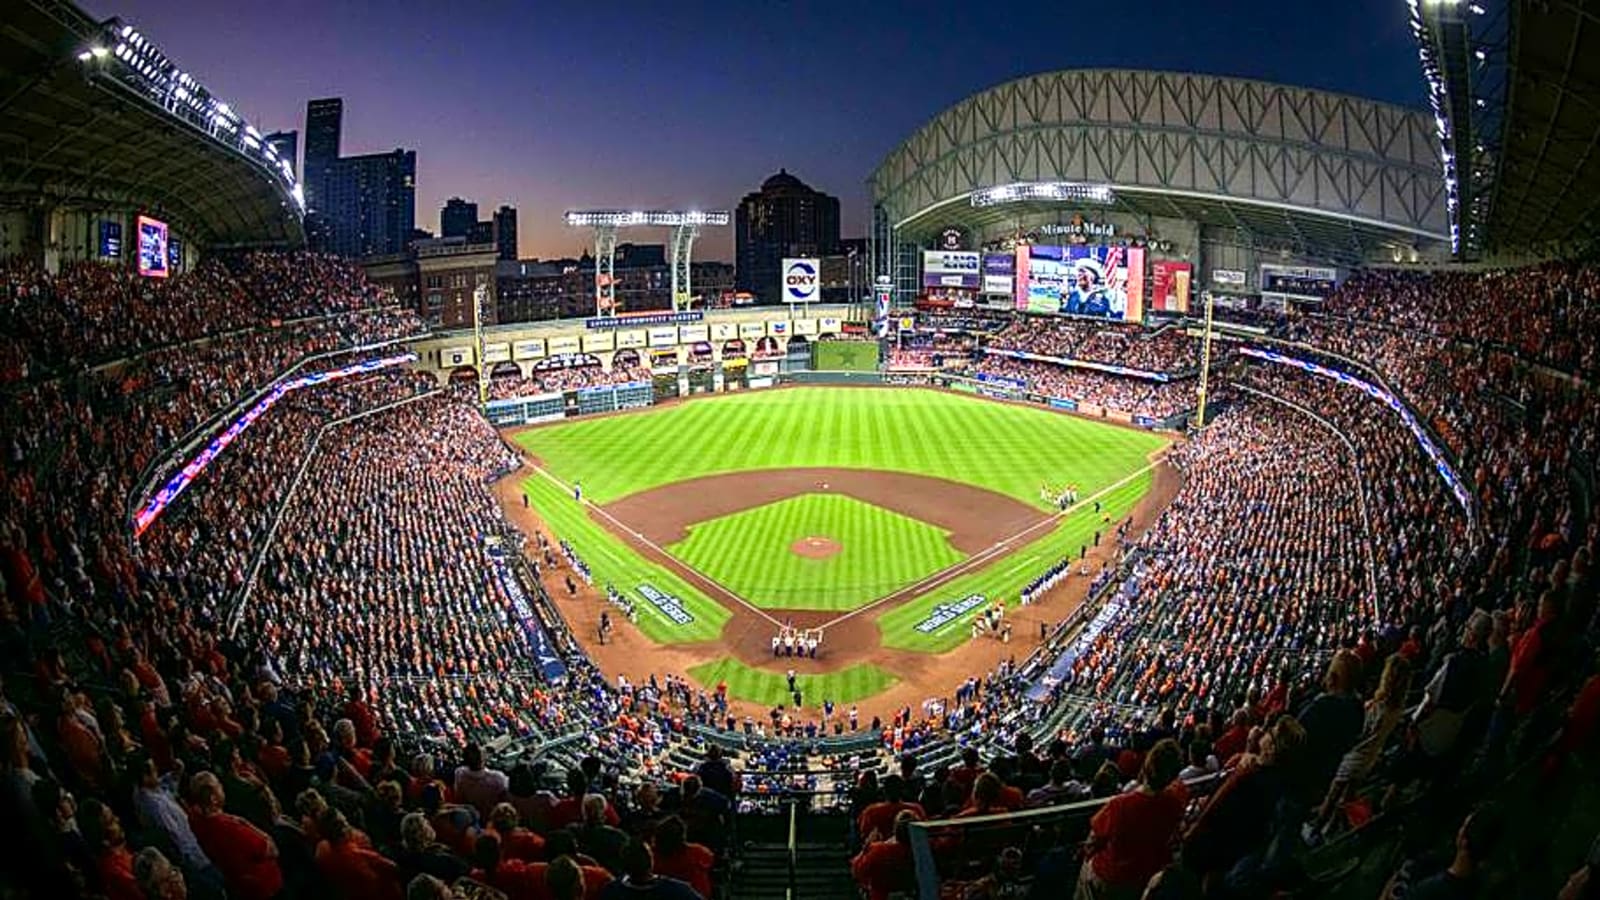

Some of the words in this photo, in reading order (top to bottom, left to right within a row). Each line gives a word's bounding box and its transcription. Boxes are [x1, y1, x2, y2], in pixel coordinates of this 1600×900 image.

[1040, 223, 1081, 236] Minute
[1083, 221, 1114, 236] Maid
[786, 275, 816, 286] OXY
